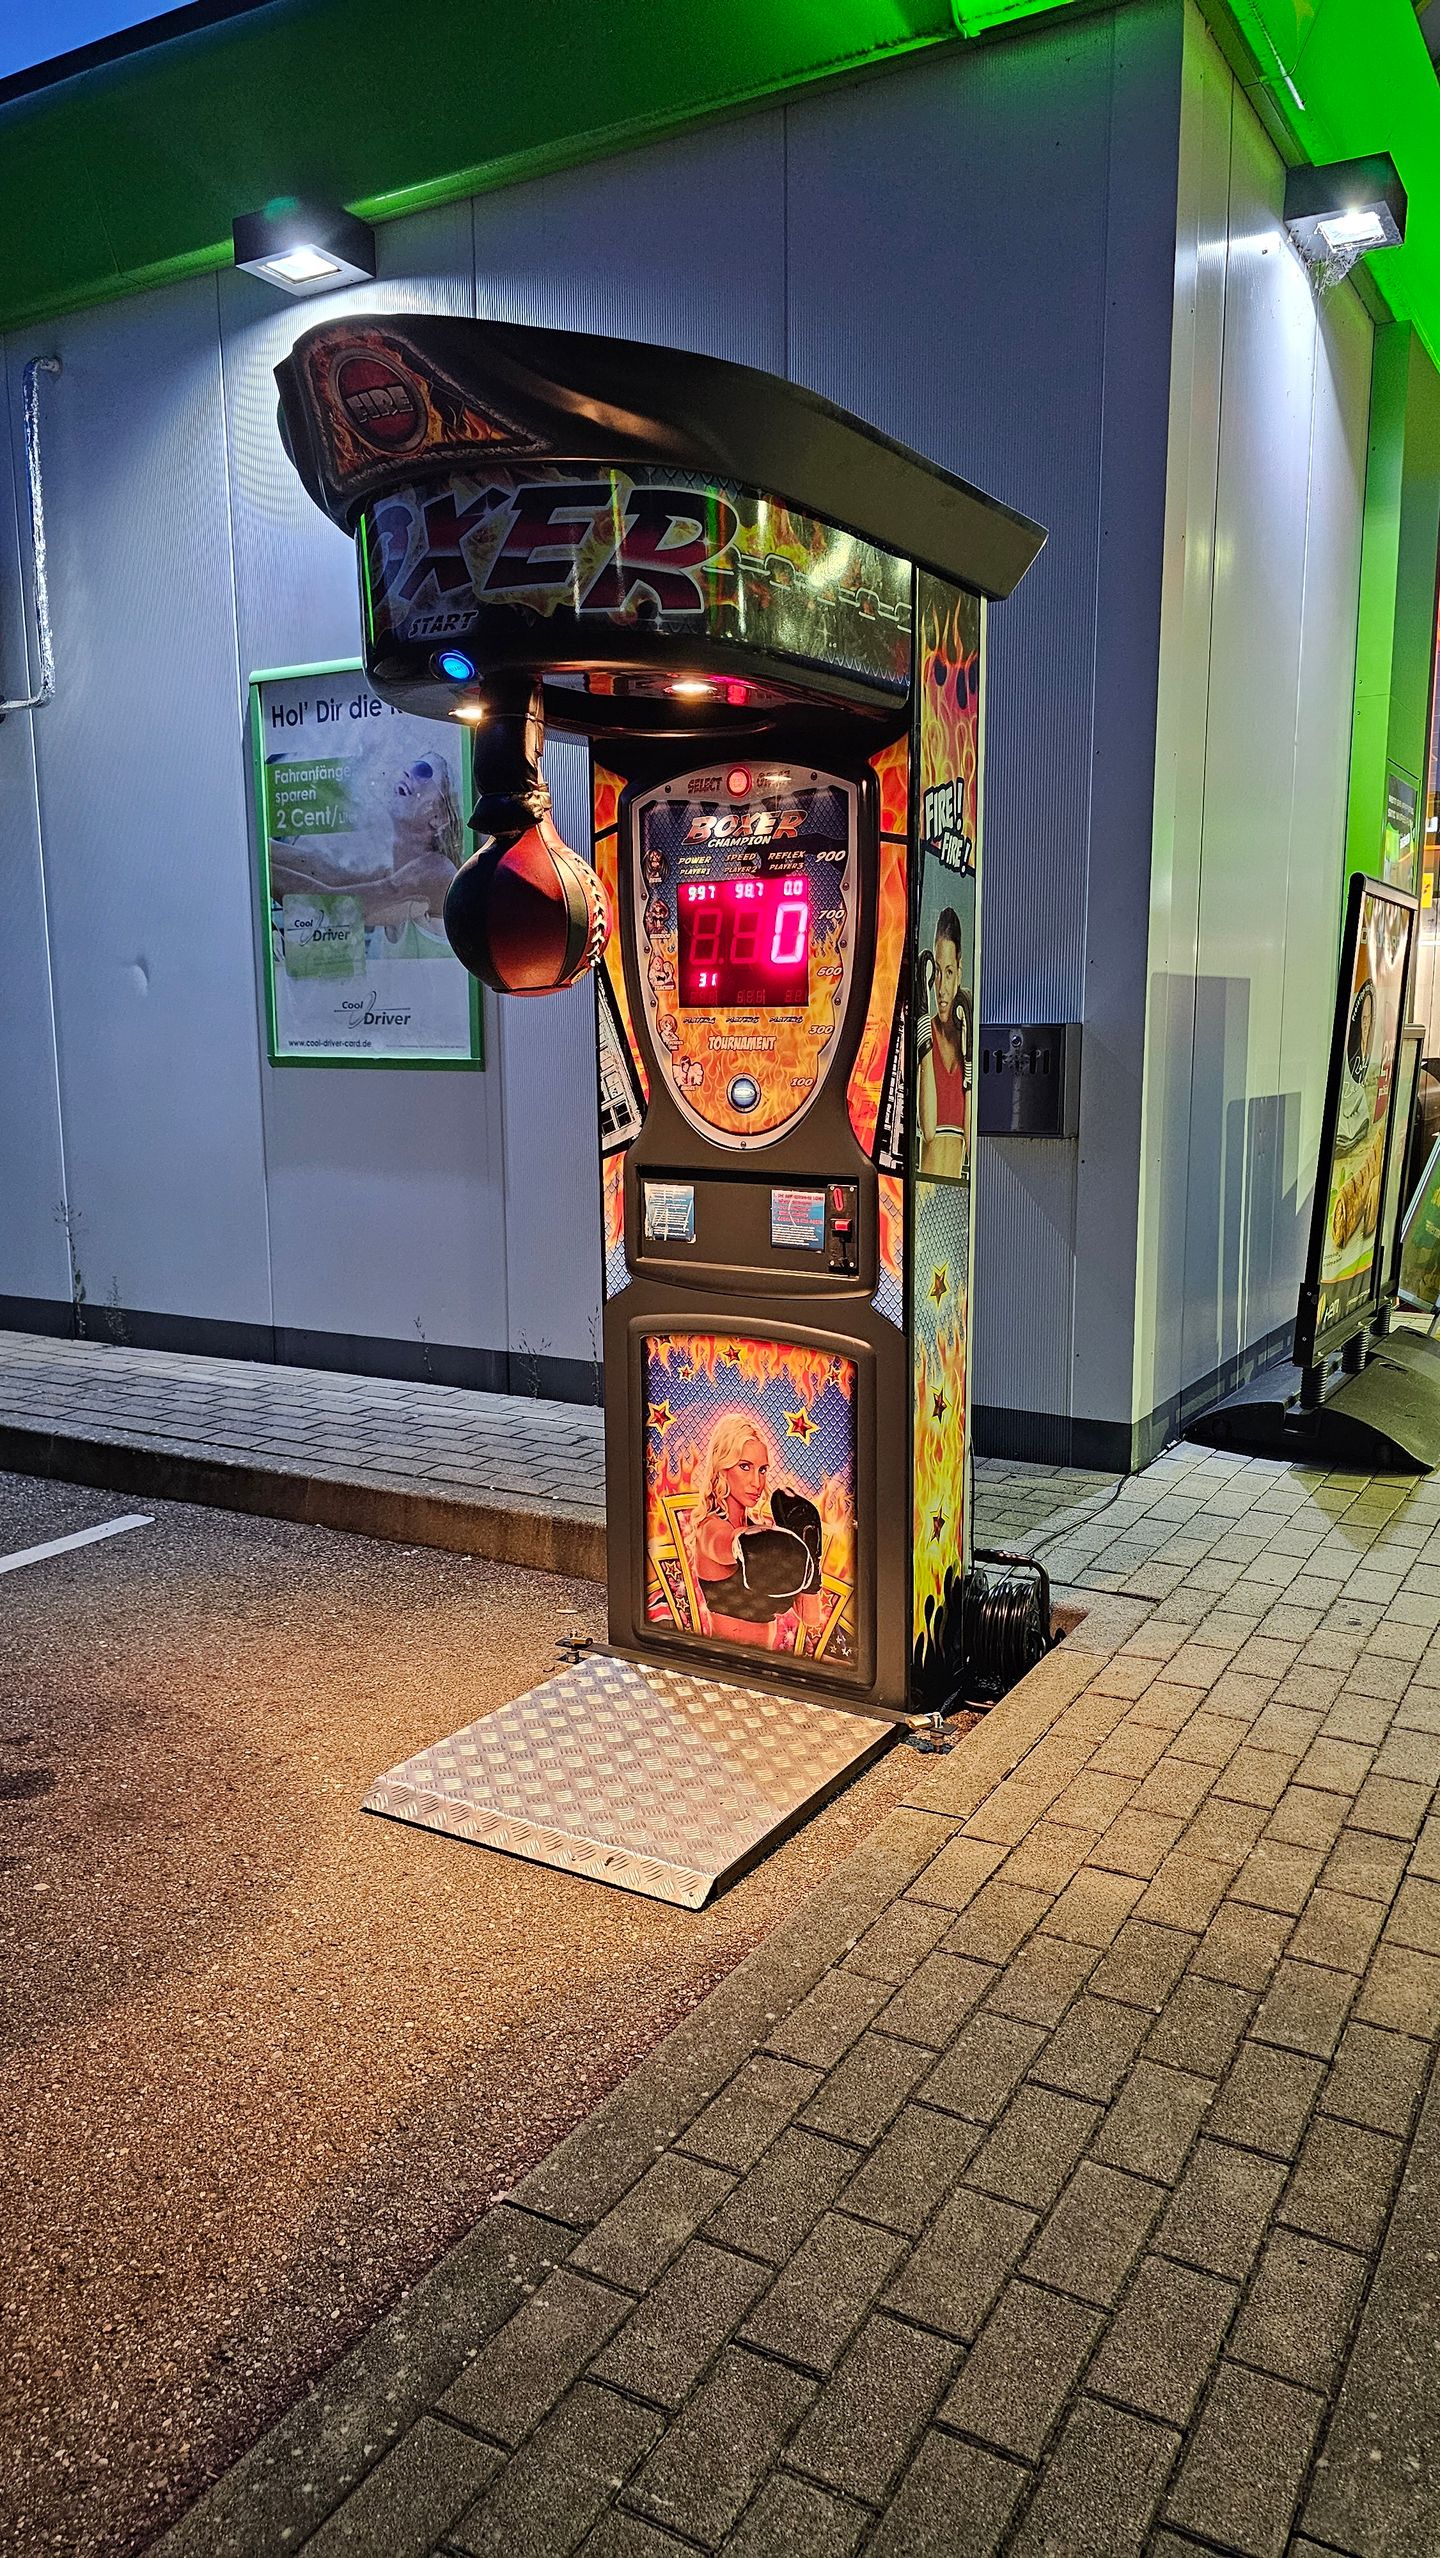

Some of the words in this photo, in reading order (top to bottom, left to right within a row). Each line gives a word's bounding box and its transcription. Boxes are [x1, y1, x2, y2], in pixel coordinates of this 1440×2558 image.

[408, 609, 479, 638] START
[272, 701, 308, 728] Hol'
[316, 698, 342, 723] Dir
[349, 694, 382, 719] die
[274, 765, 352, 785] Fahranfänge
[688, 776, 722, 794] SELECT
[275, 788, 317, 806] sparen
[276, 809, 287, 829] 2
[682, 810, 808, 845] BOXER
[708, 836, 773, 848] CHAMPION
[677, 856, 712, 865] POWER
[725, 853, 757, 862] SPEED
[768, 851, 806, 860] REFLEX
[815, 850, 847, 862] 900
[818, 909, 845, 920] 700
[294, 919, 313, 928] Cool
[313, 928, 350, 941] Driver
[771, 903, 808, 964] 0
[817, 966, 843, 976] 500
[698, 973, 718, 988] 31
[342, 1001, 364, 1010] Cool
[363, 1012, 411, 1026] Driver
[809, 1025, 835, 1034] 300
[288, 1039, 372, 1049] www.cool-driver-card.de
[708, 1035, 777, 1051] TOURNAMENT
[790, 1077, 814, 1086] 100
